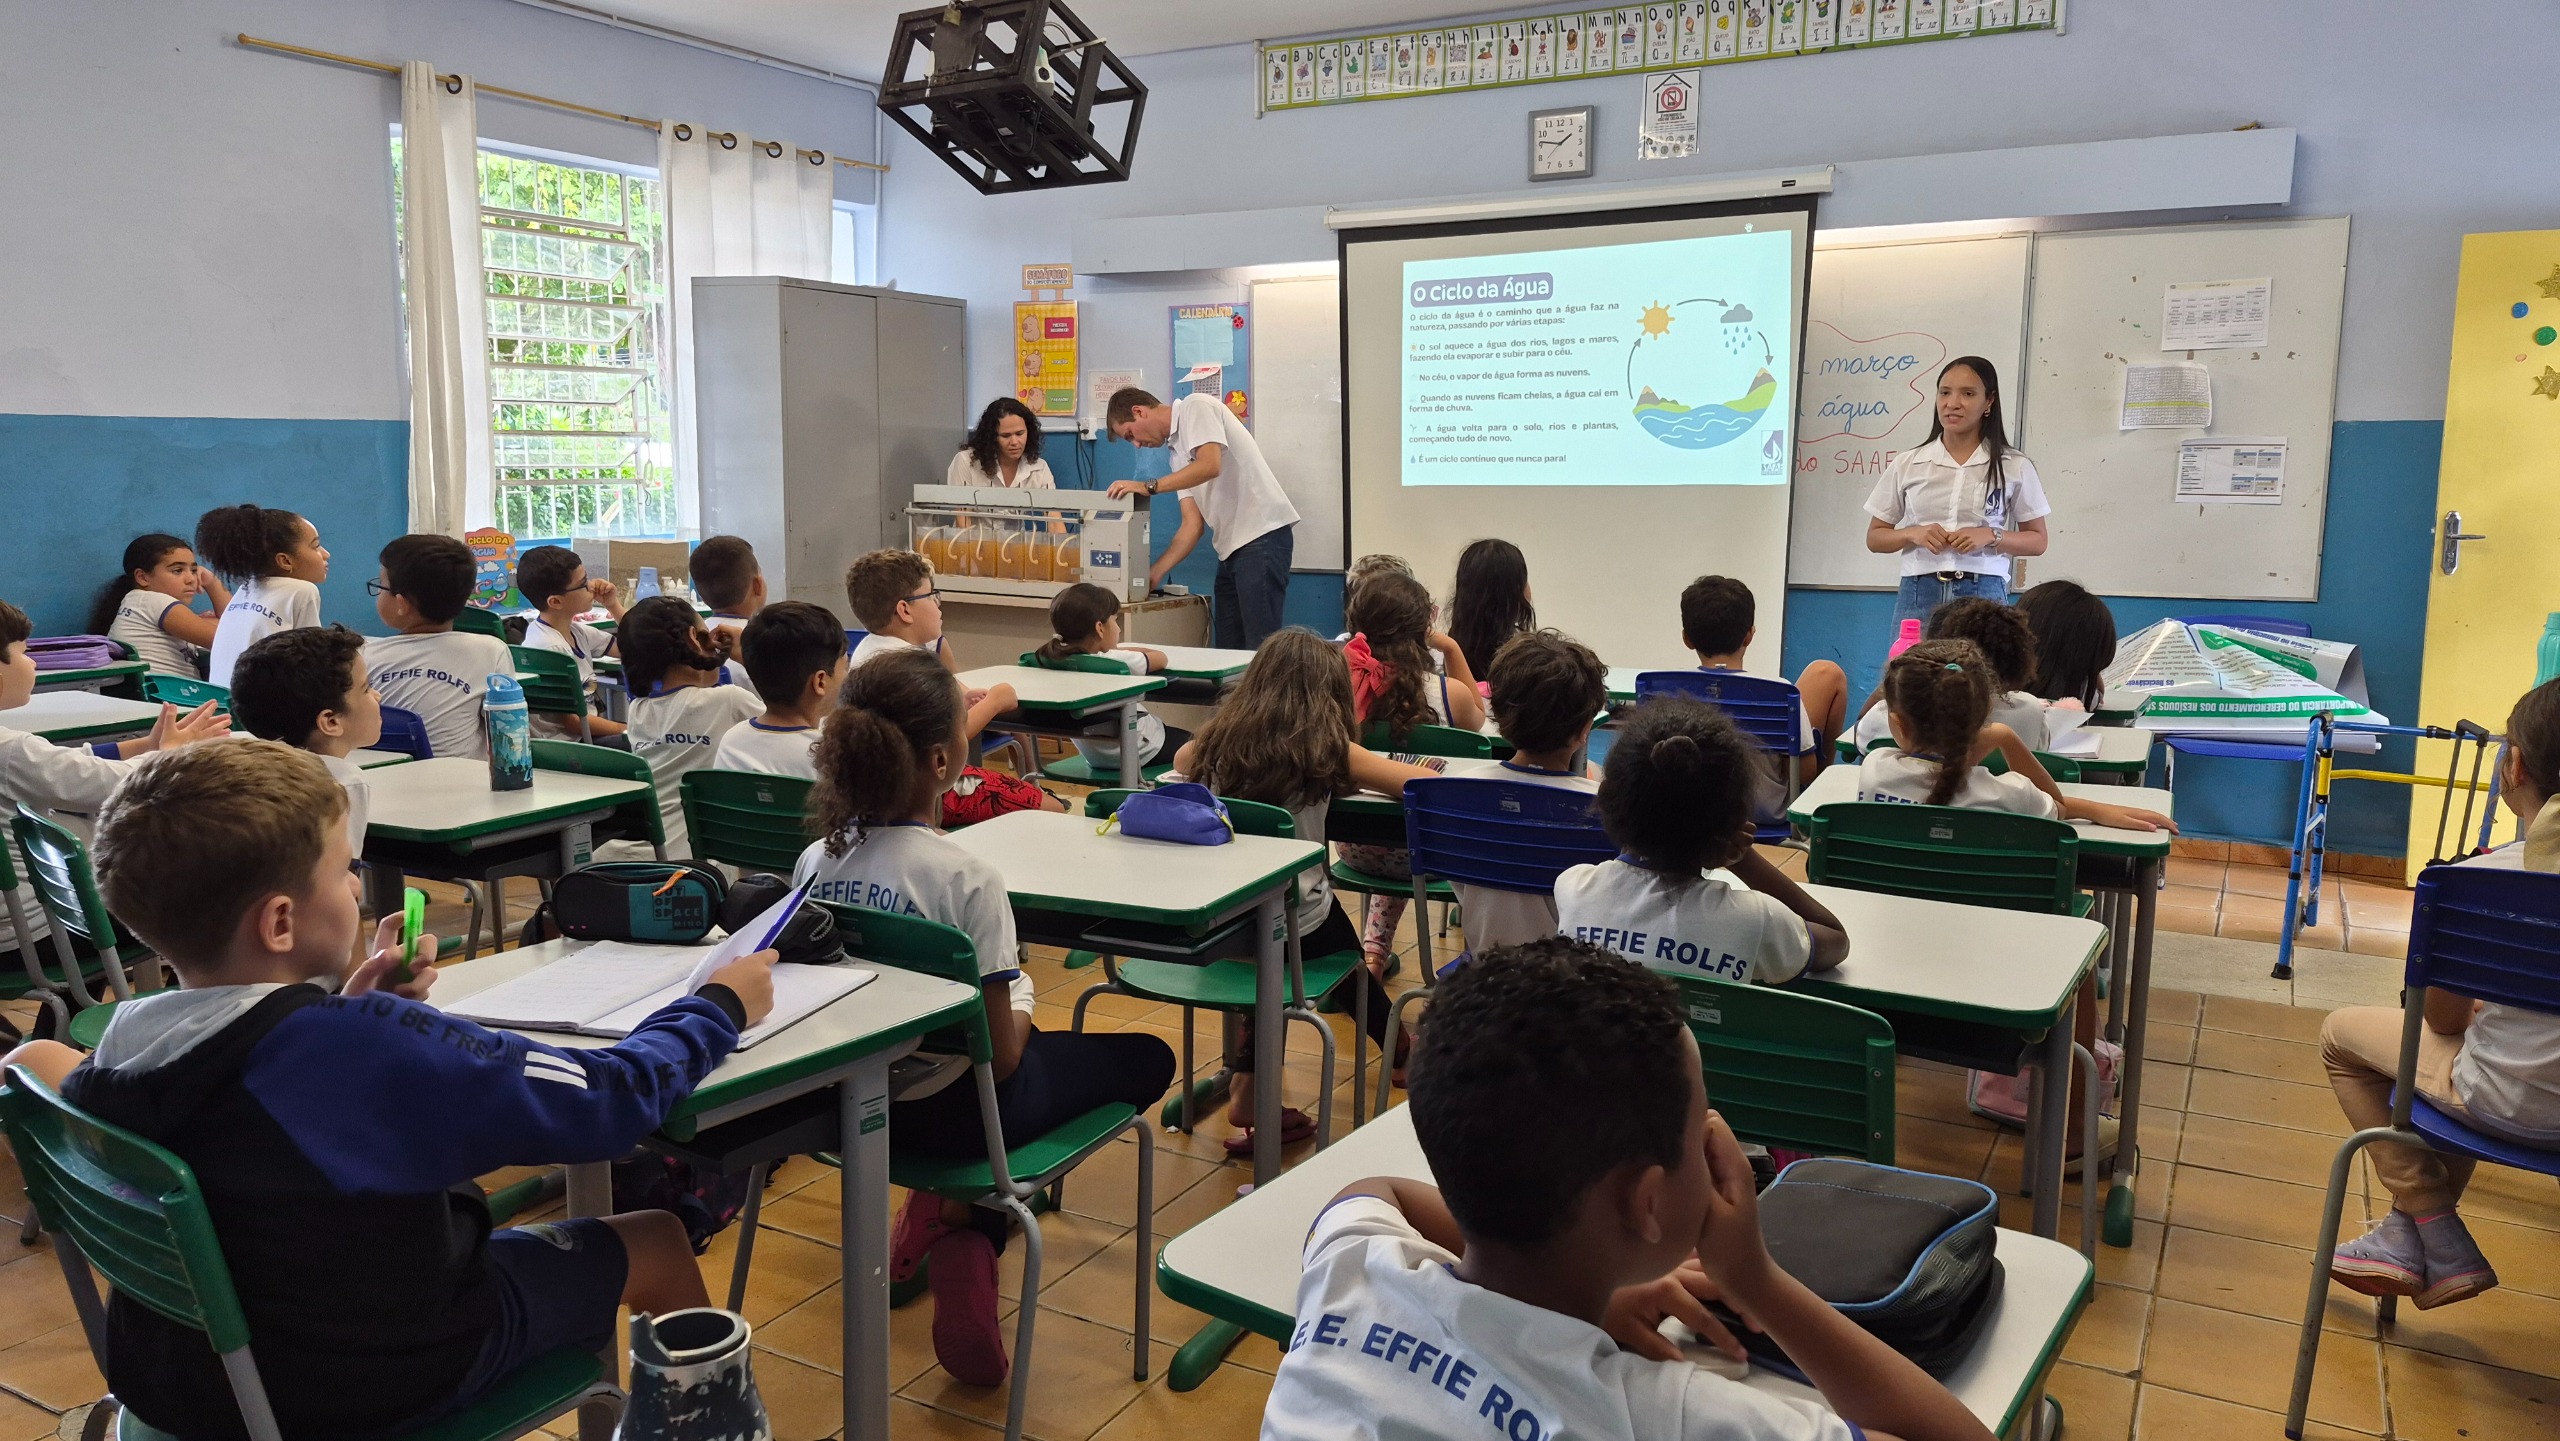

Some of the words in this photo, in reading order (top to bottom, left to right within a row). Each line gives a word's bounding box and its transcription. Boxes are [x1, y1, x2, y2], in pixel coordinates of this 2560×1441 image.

[1679, 4, 1687, 16] P
[1711, 0, 1719, 13] Q
[1618, 12, 1626, 25] N
[1649, 8, 1657, 21] O
[1560, 19, 1567, 33] L
[1588, 16, 1597, 28] M
[1503, 26, 1509, 39] J
[1531, 23, 1539, 36] K
[1421, 34, 1429, 47] G
[1448, 32, 1456, 45] H
[1344, 44, 1350, 57] D
[1369, 41, 1375, 54] E
[1395, 39, 1401, 52] F
[1268, 52, 1275, 64] A
[1293, 50, 1300, 62] B
[1319, 47, 1325, 60] C
[1545, 120, 1553, 128] 11
[1556, 119, 1565, 127] 12
[1538, 130, 1547, 138] 10
[1578, 125, 1583, 133] 2
[1578, 138, 1583, 146] 3
[1538, 154, 1543, 162] 8
[1578, 150, 1583, 158] 4
[1547, 161, 1552, 169] 7
[1569, 160, 1574, 168] 5
[1027, 267, 1068, 280] SEMÁFORO
[1414, 287, 1426, 302] O
[1430, 282, 1473, 301] Ciclo
[1477, 281, 1499, 299] da
[1503, 276, 1549, 300] Água
[1179, 305, 1233, 319] CALENDÁRIO
[1455, 311, 1475, 320] água
[1496, 308, 1532, 316] caminho
[1536, 308, 1552, 316] que
[1565, 304, 1586, 314] água
[1591, 303, 1604, 311] faz
[1449, 321, 1488, 331] passando
[1506, 318, 1532, 326] várias
[1534, 318, 1565, 326] etapas:
[1445, 343, 1474, 352] aquece
[1487, 340, 1507, 349] água
[1530, 338, 1548, 346] rios,
[1552, 338, 1575, 347] lagos
[1410, 353, 1441, 361] fazendo
[1457, 353, 1494, 361] evaporar
[1503, 350, 1524, 358] subir
[1555, 348, 1573, 356] céu.
[1819, 355, 1920, 380] março
[1432, 373, 1448, 381] céu,
[1494, 371, 1514, 380] água
[1421, 394, 1451, 403] Quando
[1498, 392, 1521, 400] ficam
[1524, 391, 1554, 400] cheias,
[1564, 390, 1585, 399] água
[1589, 389, 1601, 397] cai
[1817, 395, 1890, 433] água
[1437, 424, 1456, 433] água
[1524, 423, 1543, 431] solo,
[1549, 422, 1566, 430] rios
[1583, 422, 1618, 431] plantas,
[1409, 435, 1455, 444] começando
[1477, 434, 1487, 442] de
[1544, 455, 1566, 463] para!
[467, 535, 493, 545] CICLO
[494, 535, 509, 545] DA
[472, 546, 496, 556] ÁGUA
[250, 602, 283, 627] ROLFS
[381, 668, 423, 684] EFFIE
[426, 668, 471, 695] ROLFS
[2159, 702, 2198, 713] RESÍDUOS
[2200, 702, 2216, 712] DOS
[2219, 702, 2286, 712] GERENCIAMENTO
[2289, 702, 2300, 712] DO
[866, 883, 919, 916] ROLF
[1655, 936, 1747, 981] ROLFS
[400, 1006, 440, 1036] BE
[1311, 1313, 1348, 1347] E.
[1361, 1322, 1477, 1401] EFFIE
